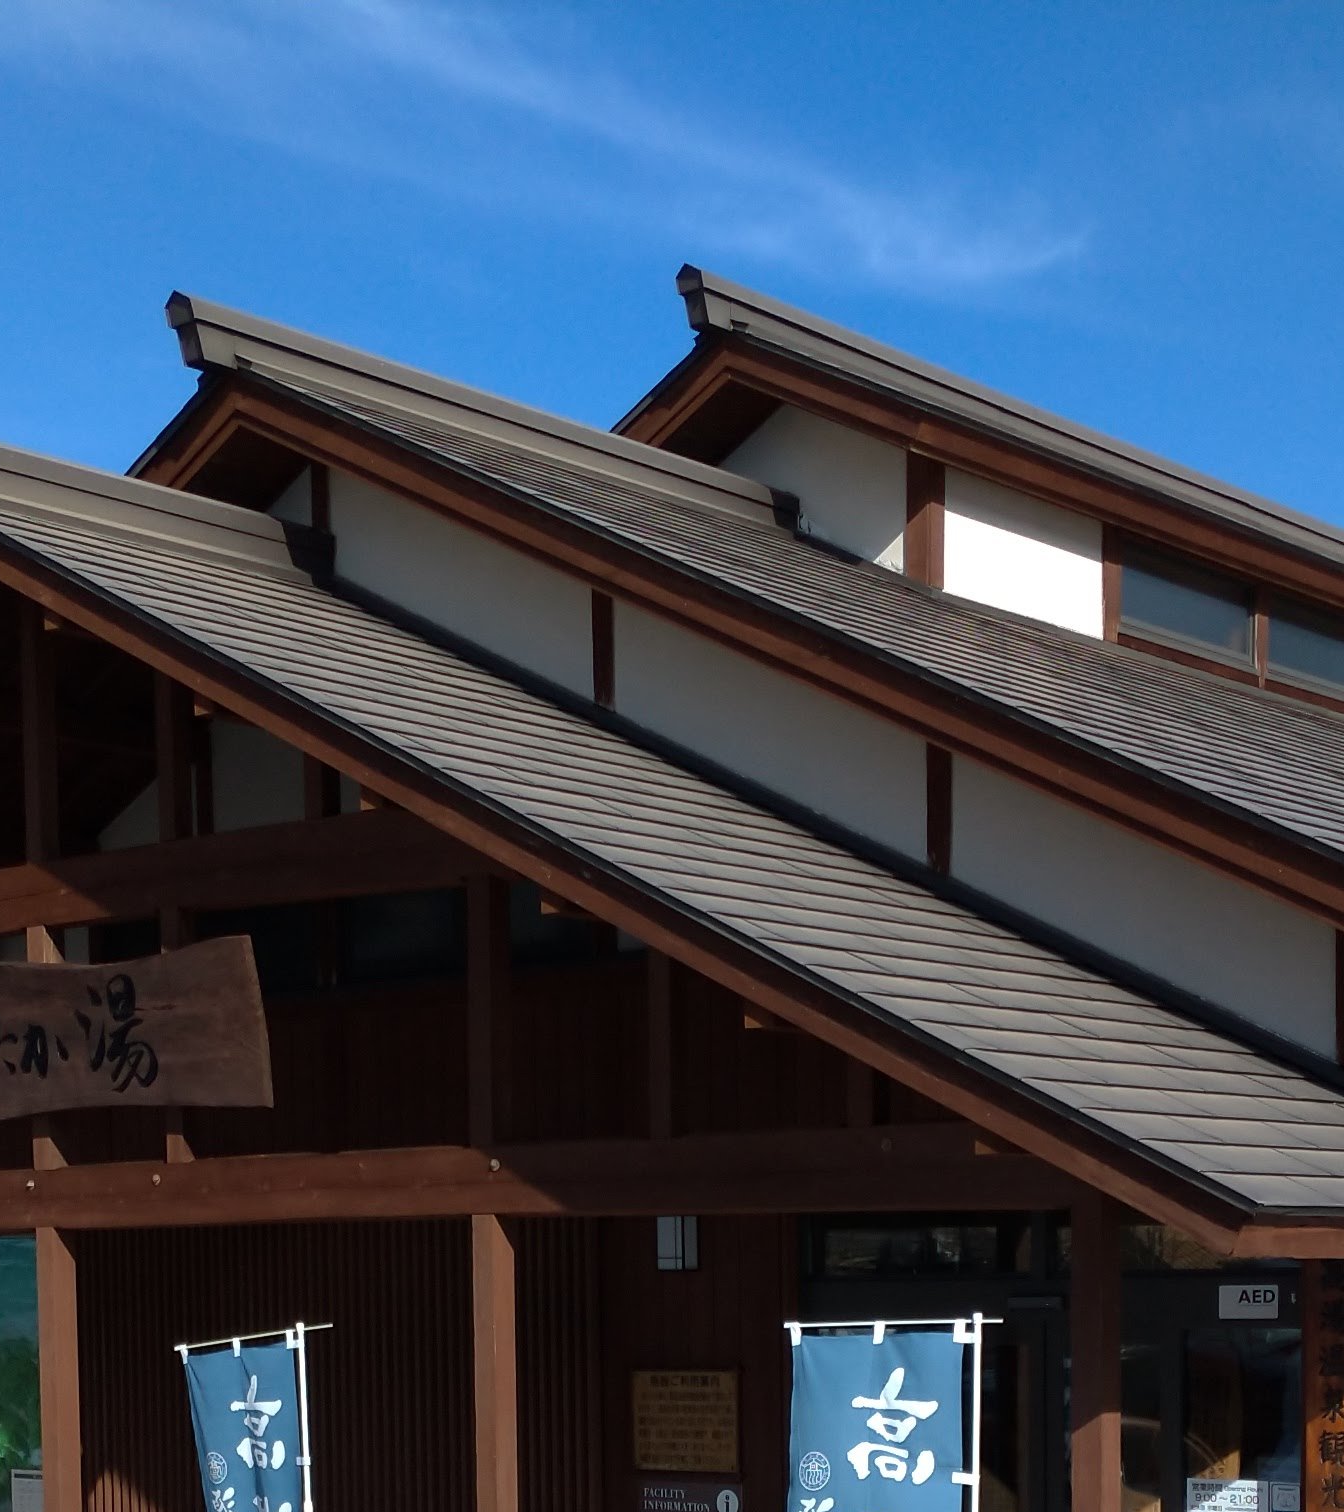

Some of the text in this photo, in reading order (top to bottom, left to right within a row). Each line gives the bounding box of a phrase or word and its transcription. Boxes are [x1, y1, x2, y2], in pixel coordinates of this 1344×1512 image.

[1238, 1289, 1276, 1304] AED
[643, 1487, 686, 1499] FACILITY
[643, 1500, 711, 1512] INFORMATION
